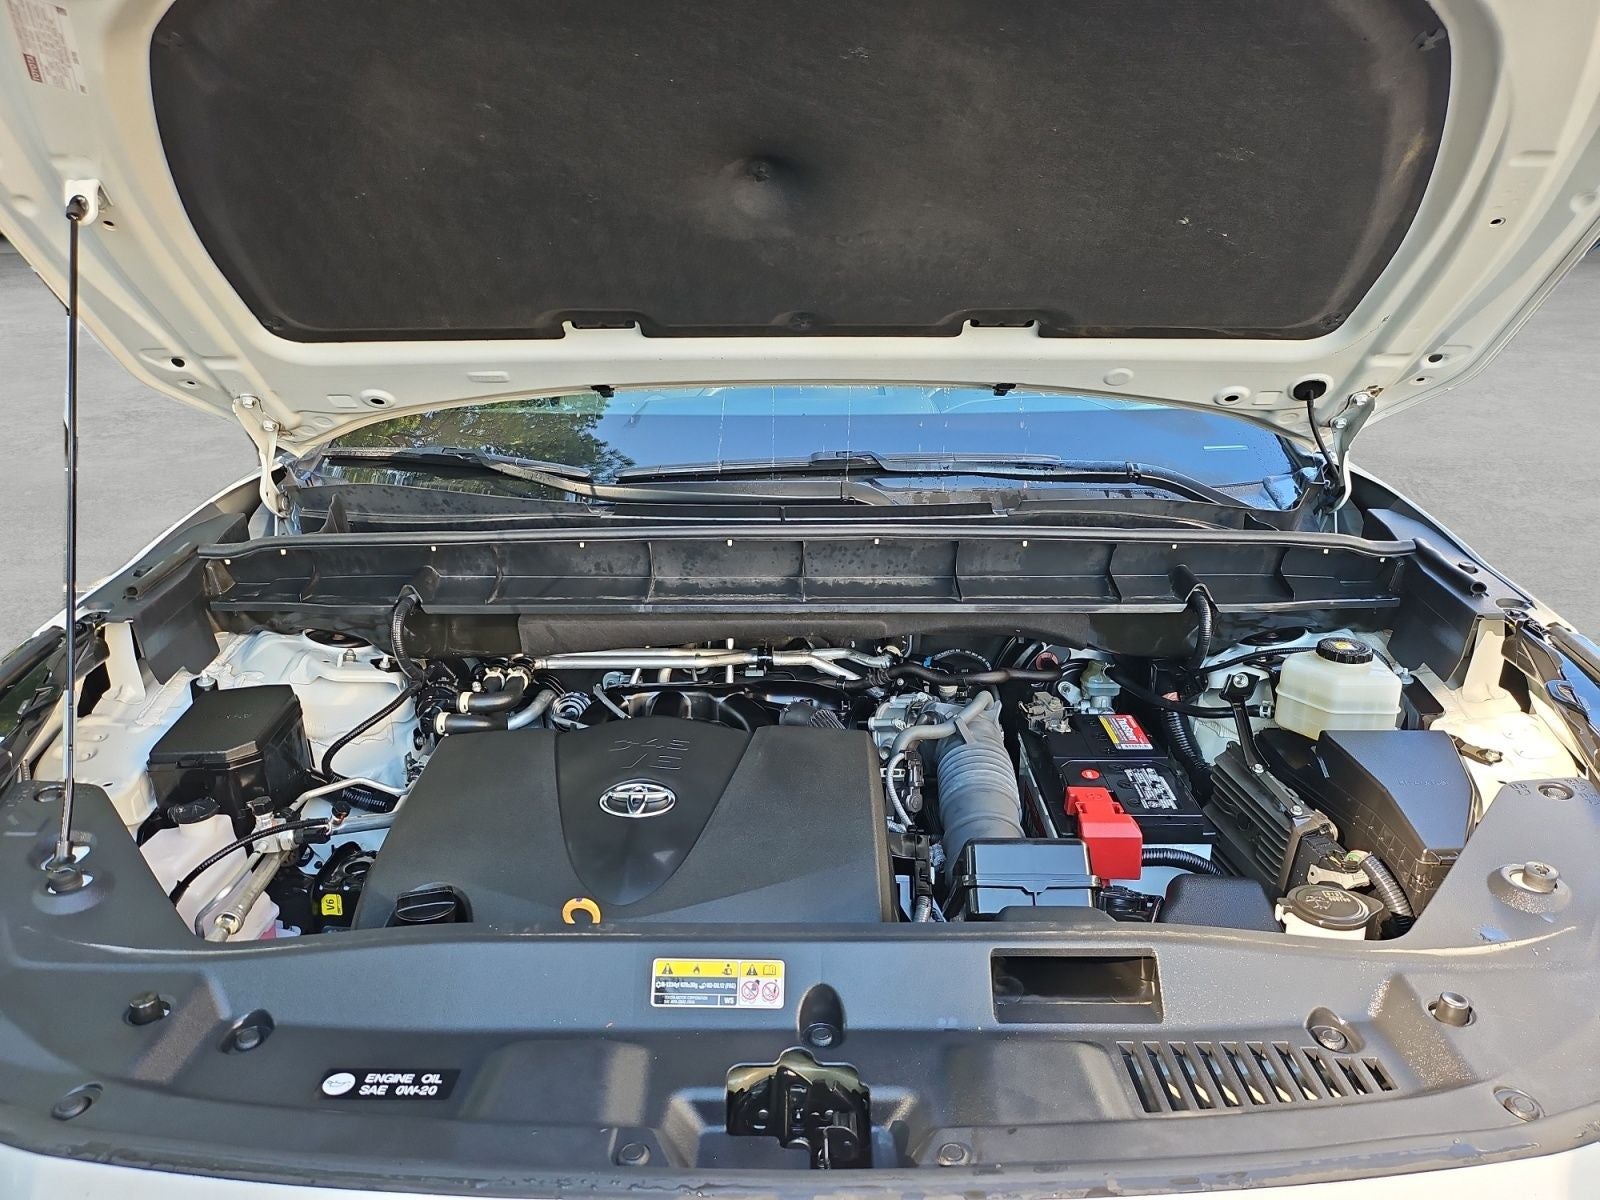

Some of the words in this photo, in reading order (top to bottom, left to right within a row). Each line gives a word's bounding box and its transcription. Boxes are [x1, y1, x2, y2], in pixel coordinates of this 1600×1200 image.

[325, 898, 335, 911] V6
[364, 1073, 416, 1084] ENGINE
[420, 1073, 443, 1084] OIL
[358, 1084, 389, 1096] SAE
[395, 1085, 438, 1096] 0W-20
